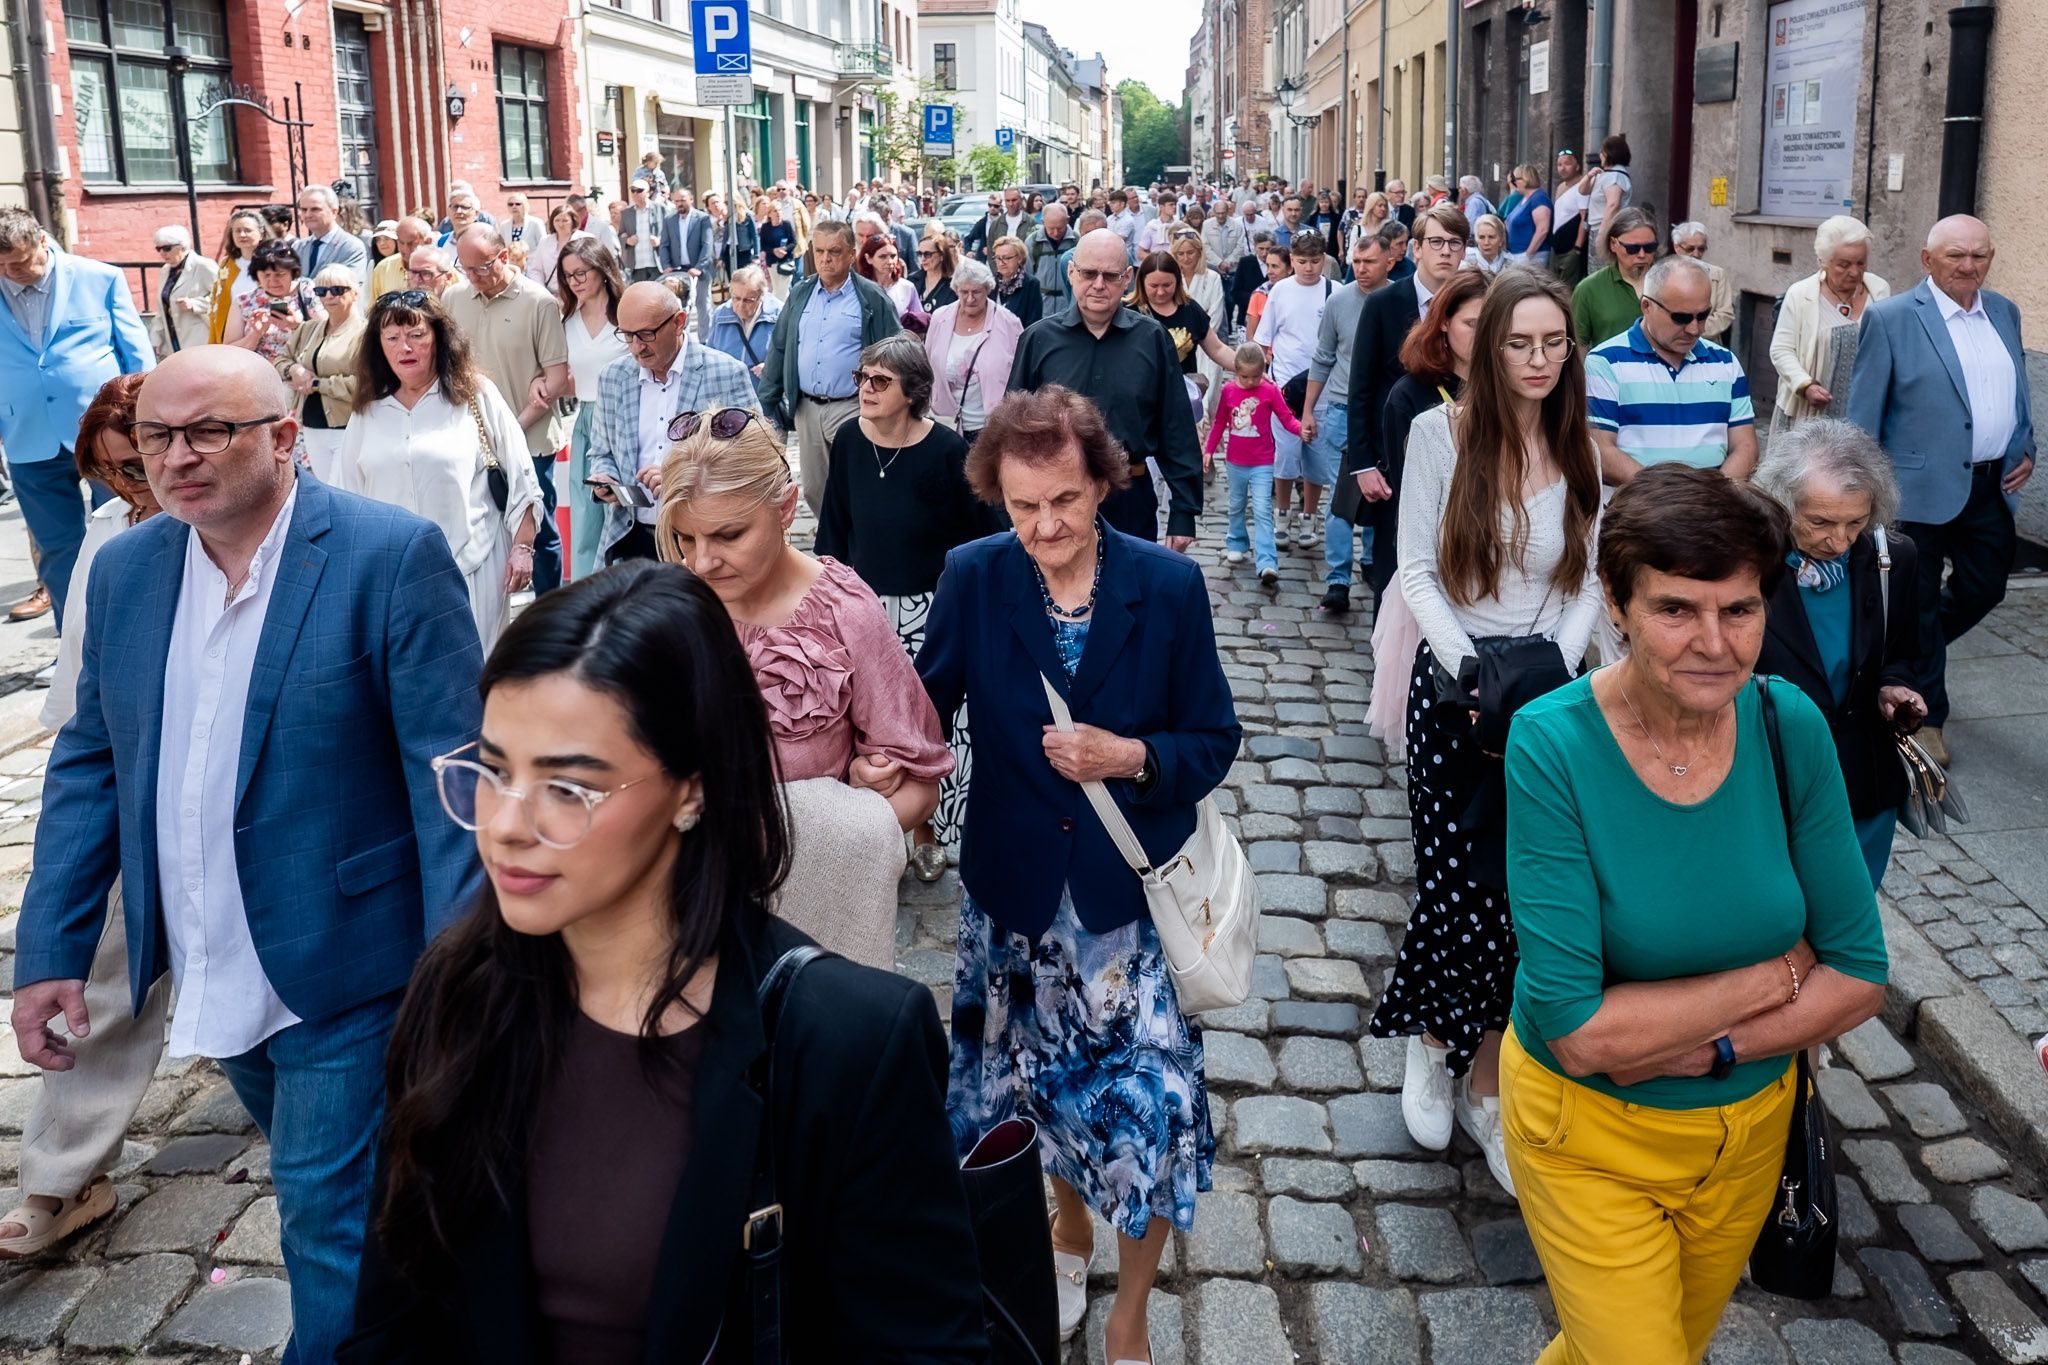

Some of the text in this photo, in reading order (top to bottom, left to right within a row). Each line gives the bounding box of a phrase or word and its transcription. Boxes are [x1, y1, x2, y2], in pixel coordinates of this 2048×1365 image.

[704, 6, 738, 53] P
[931, 108, 948, 132] P
[999, 130, 1011, 146] P
